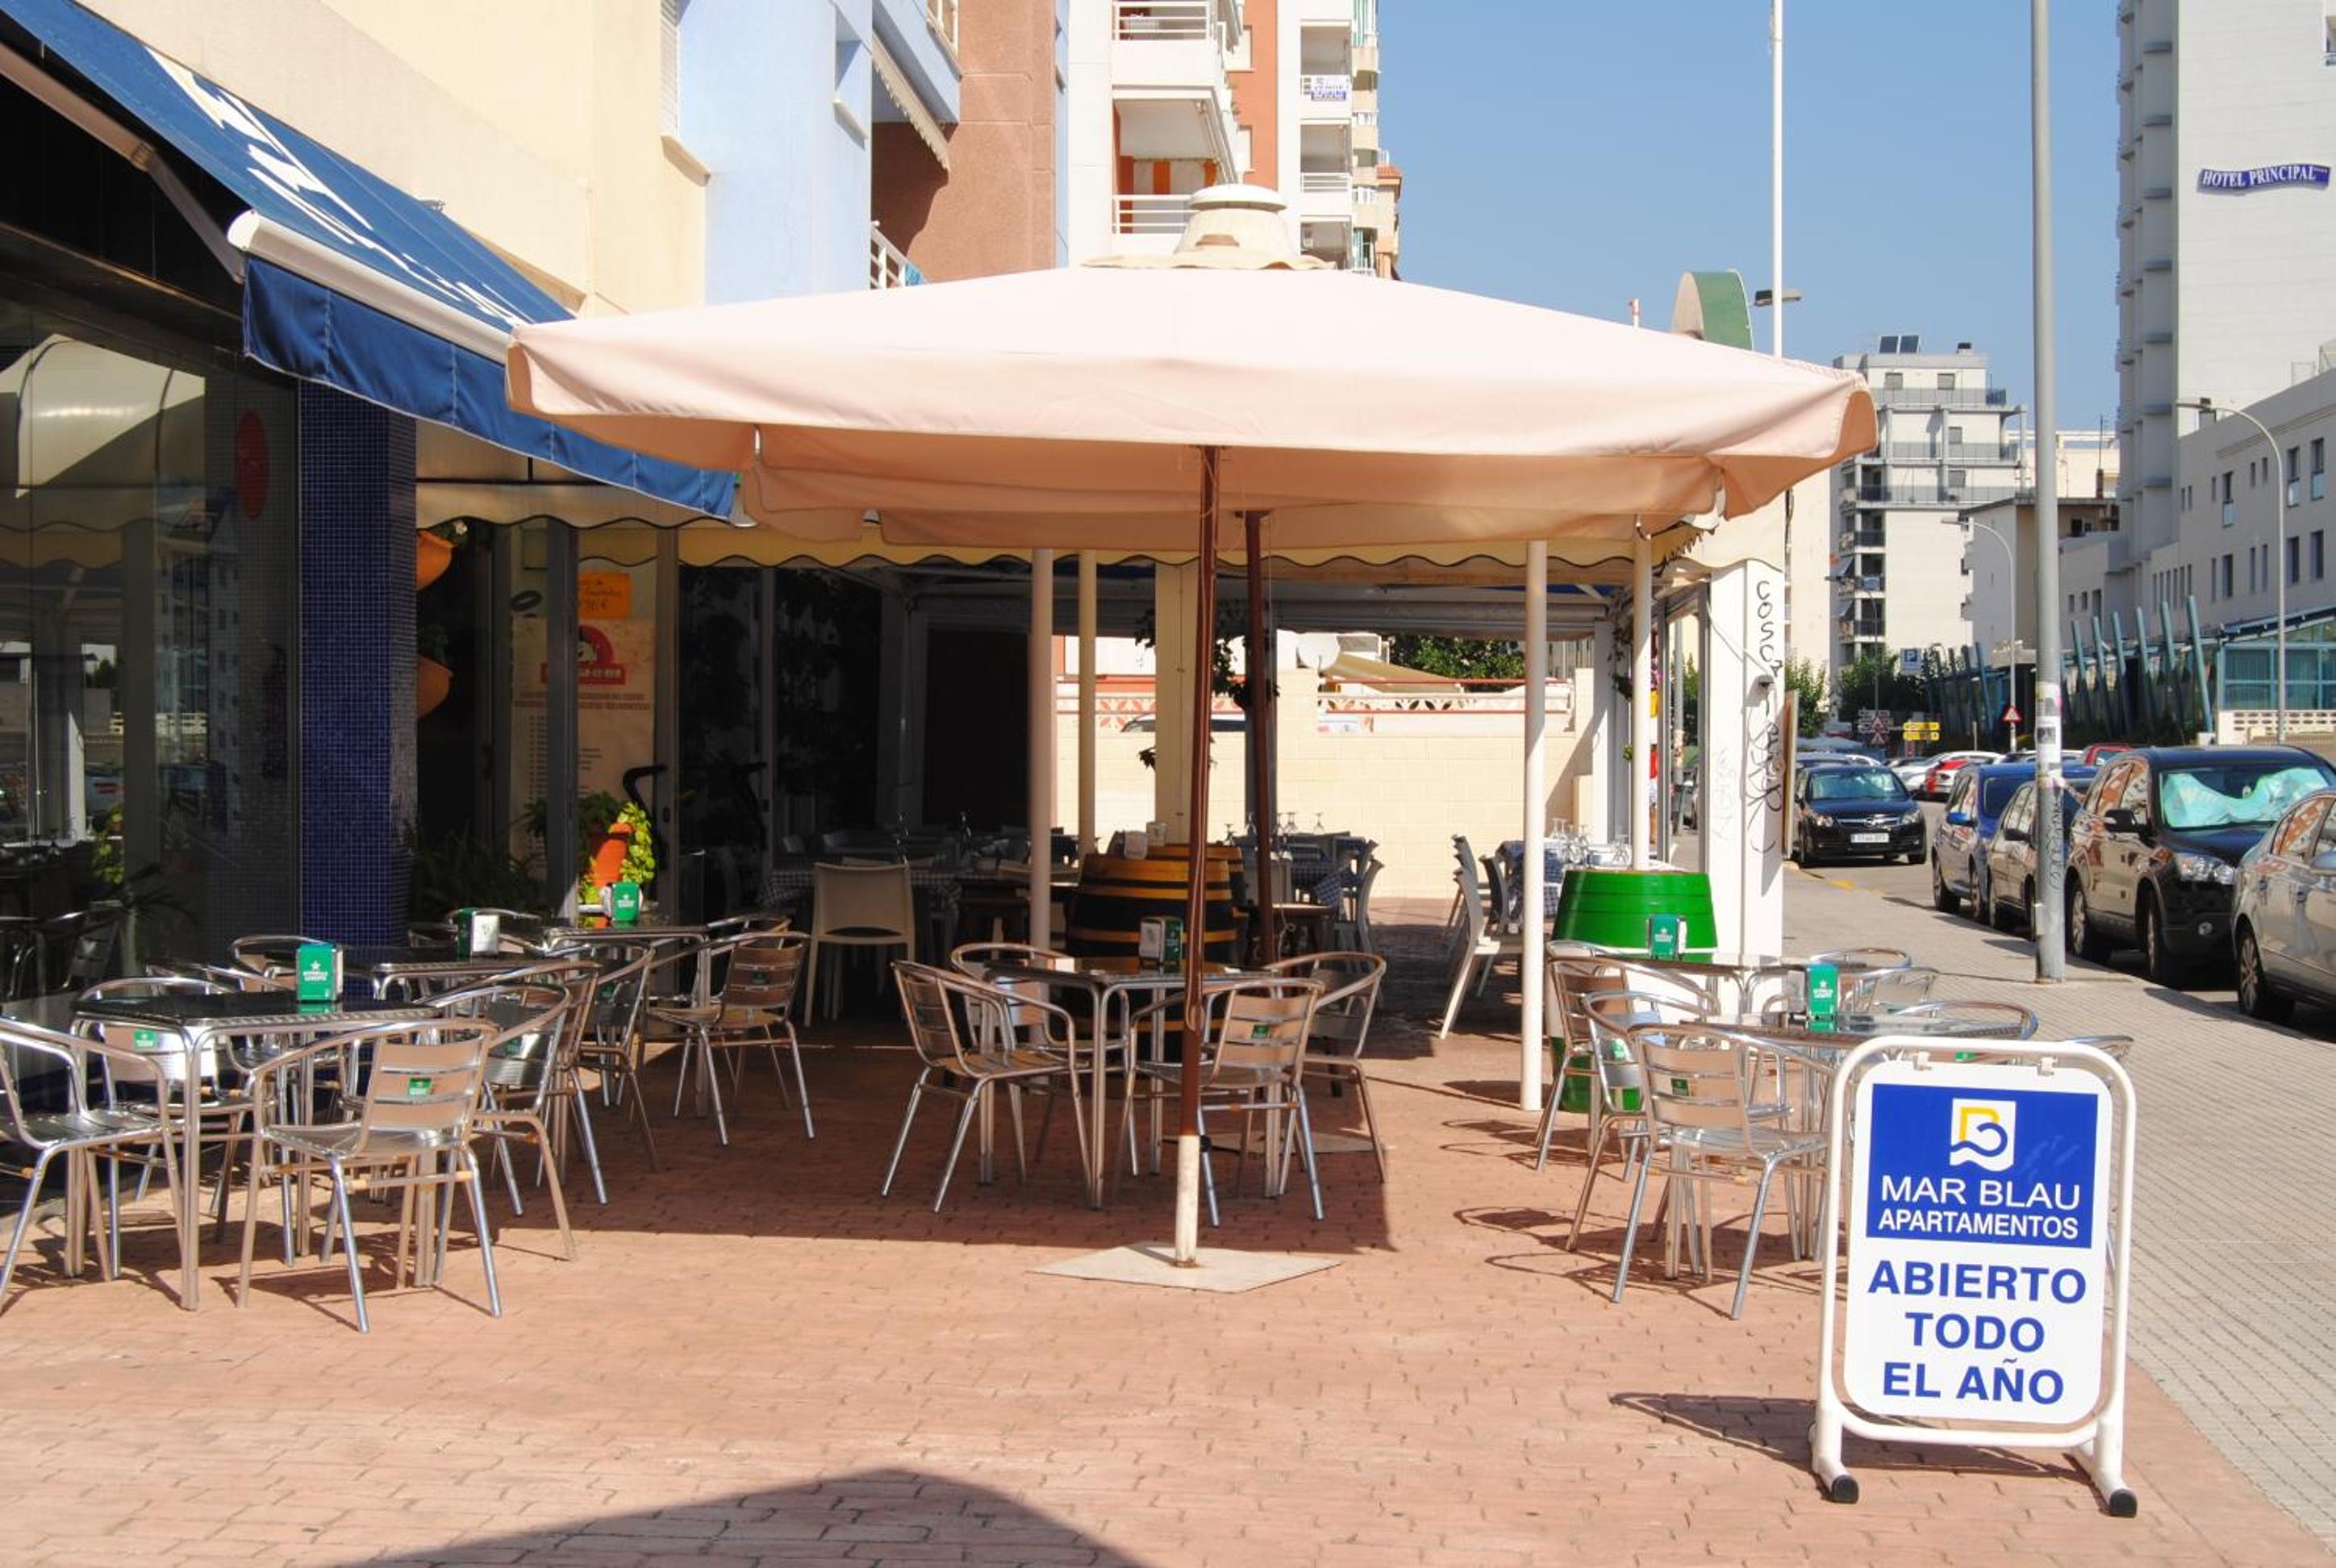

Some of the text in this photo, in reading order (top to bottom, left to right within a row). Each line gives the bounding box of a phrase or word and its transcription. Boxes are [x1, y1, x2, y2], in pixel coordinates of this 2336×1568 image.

[2202, 165, 2317, 188] HOTEL PRINCIPAL
[1882, 1174, 2080, 1211] MAR BLAU
[1878, 1208, 2079, 1240] APARTAMENTOS
[1867, 1259, 2087, 1304] ABIERTO
[1904, 1312, 2045, 1353] TODO
[1883, 1357, 2064, 1405] EL AÑO
